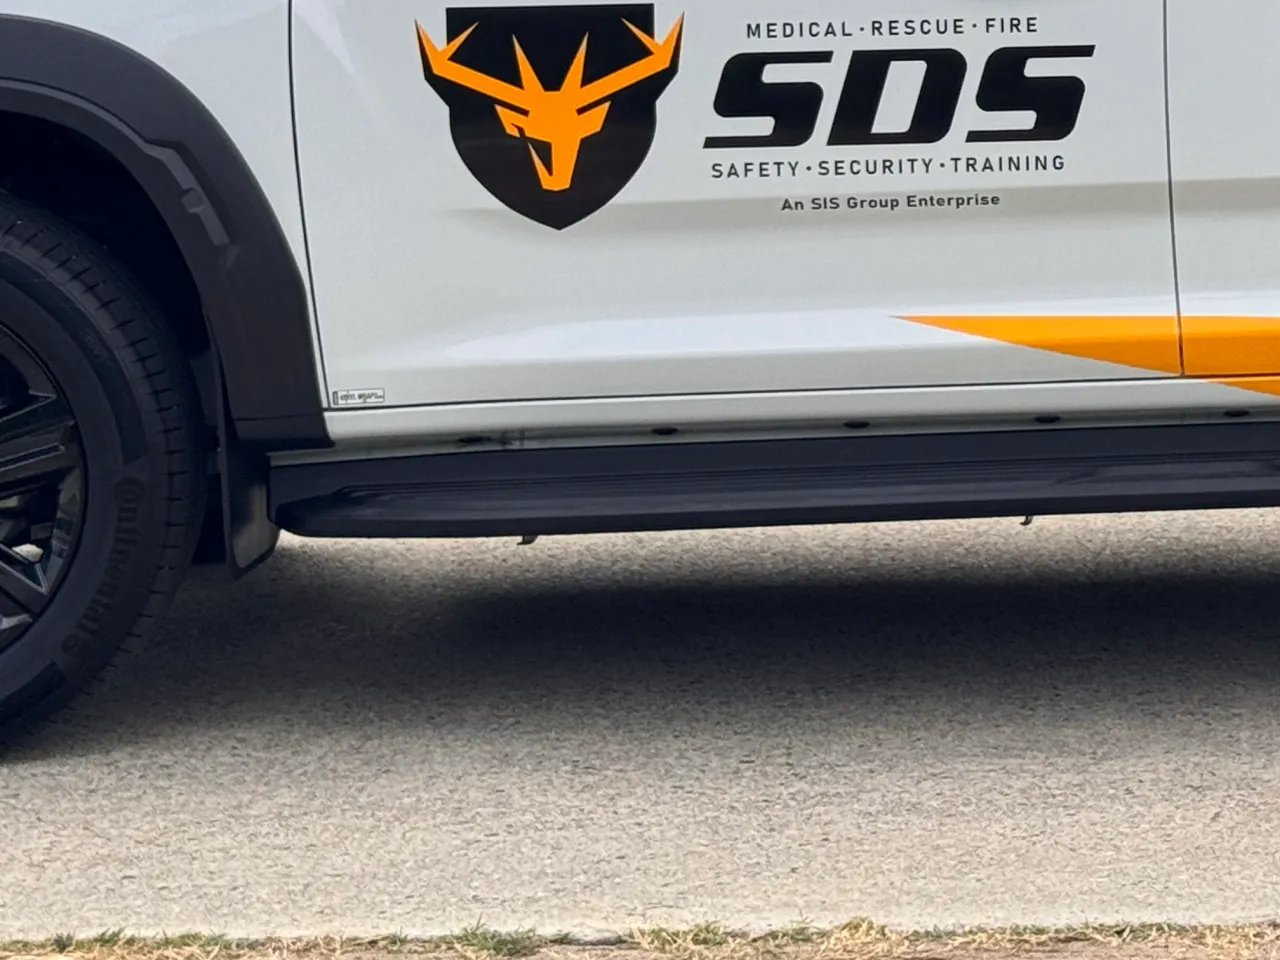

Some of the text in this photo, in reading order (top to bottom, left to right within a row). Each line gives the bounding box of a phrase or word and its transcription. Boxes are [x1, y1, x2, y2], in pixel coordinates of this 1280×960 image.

[746, 16, 1039, 39] MEDICAL RESCUE FIRE
[702, 44, 1096, 149] SDS
[711, 155, 1065, 179] SAFETY SECURITY TRAINING
[780, 193, 1001, 212] An SIS Group Enterprise
